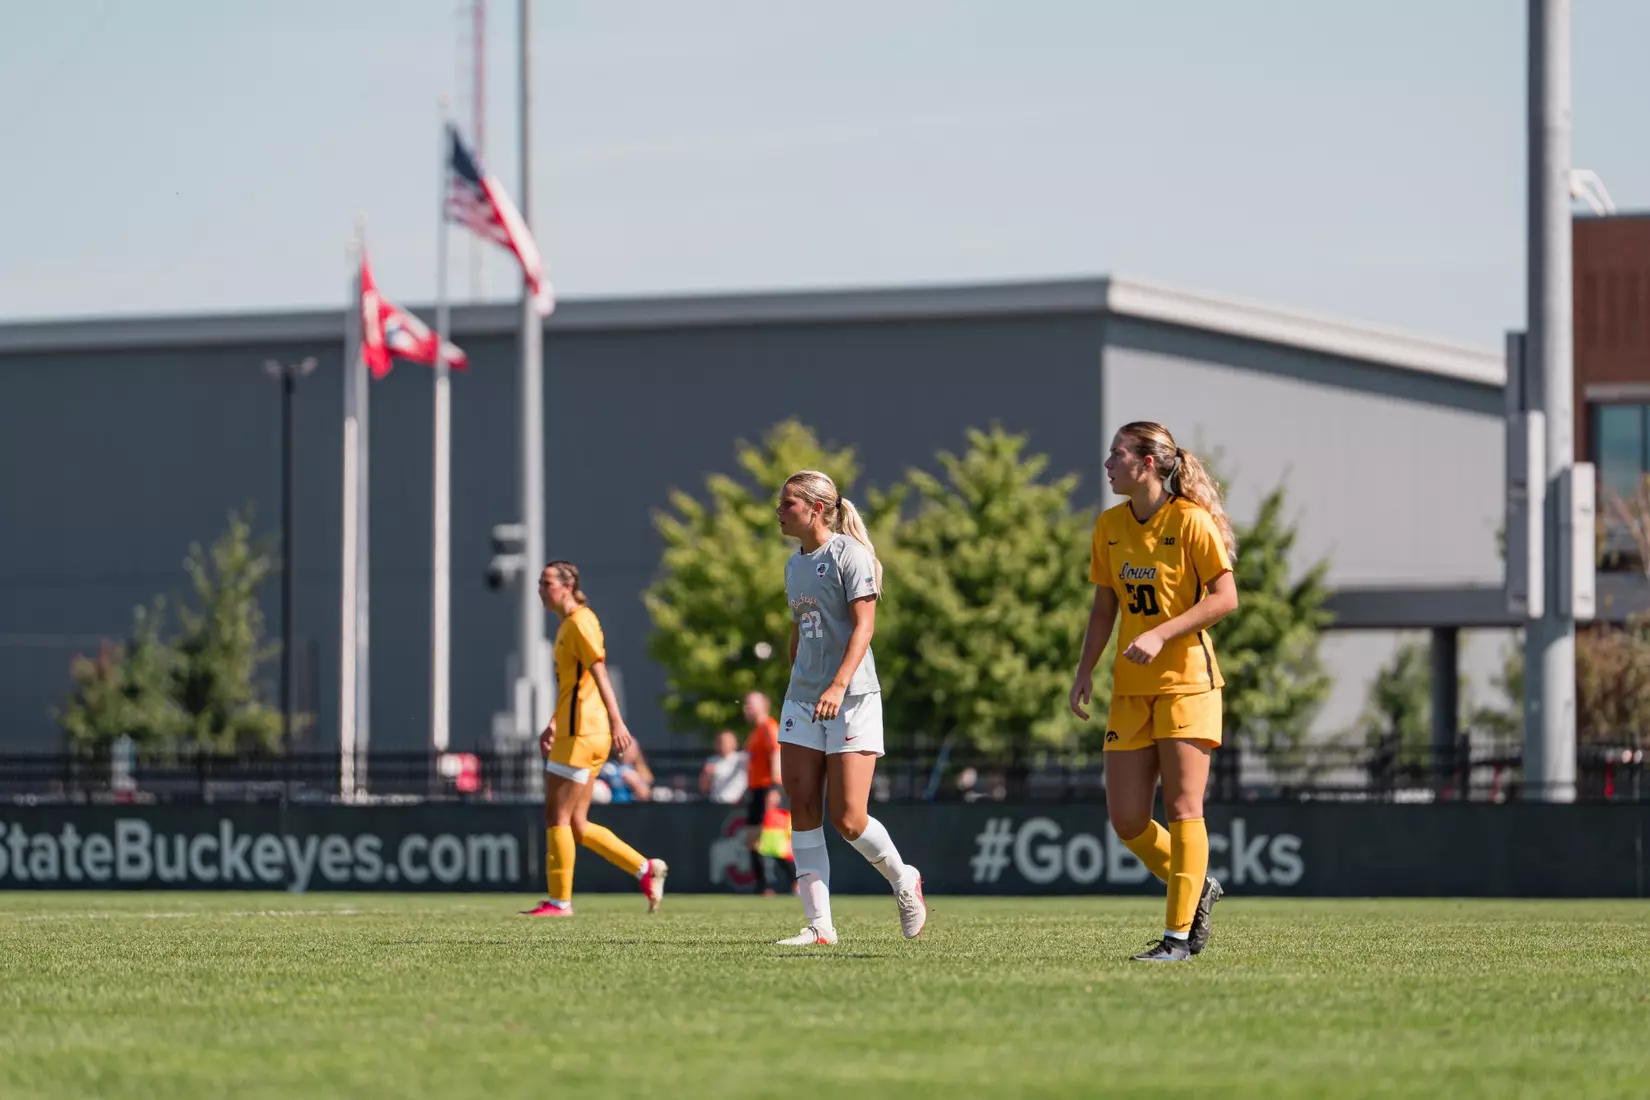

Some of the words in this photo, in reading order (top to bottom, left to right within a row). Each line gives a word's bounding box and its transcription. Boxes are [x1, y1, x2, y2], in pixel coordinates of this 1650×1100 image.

[1118, 561, 1158, 580] Iowa
[1125, 583, 1160, 616] 30
[968, 816, 1305, 886] #GoBcks
